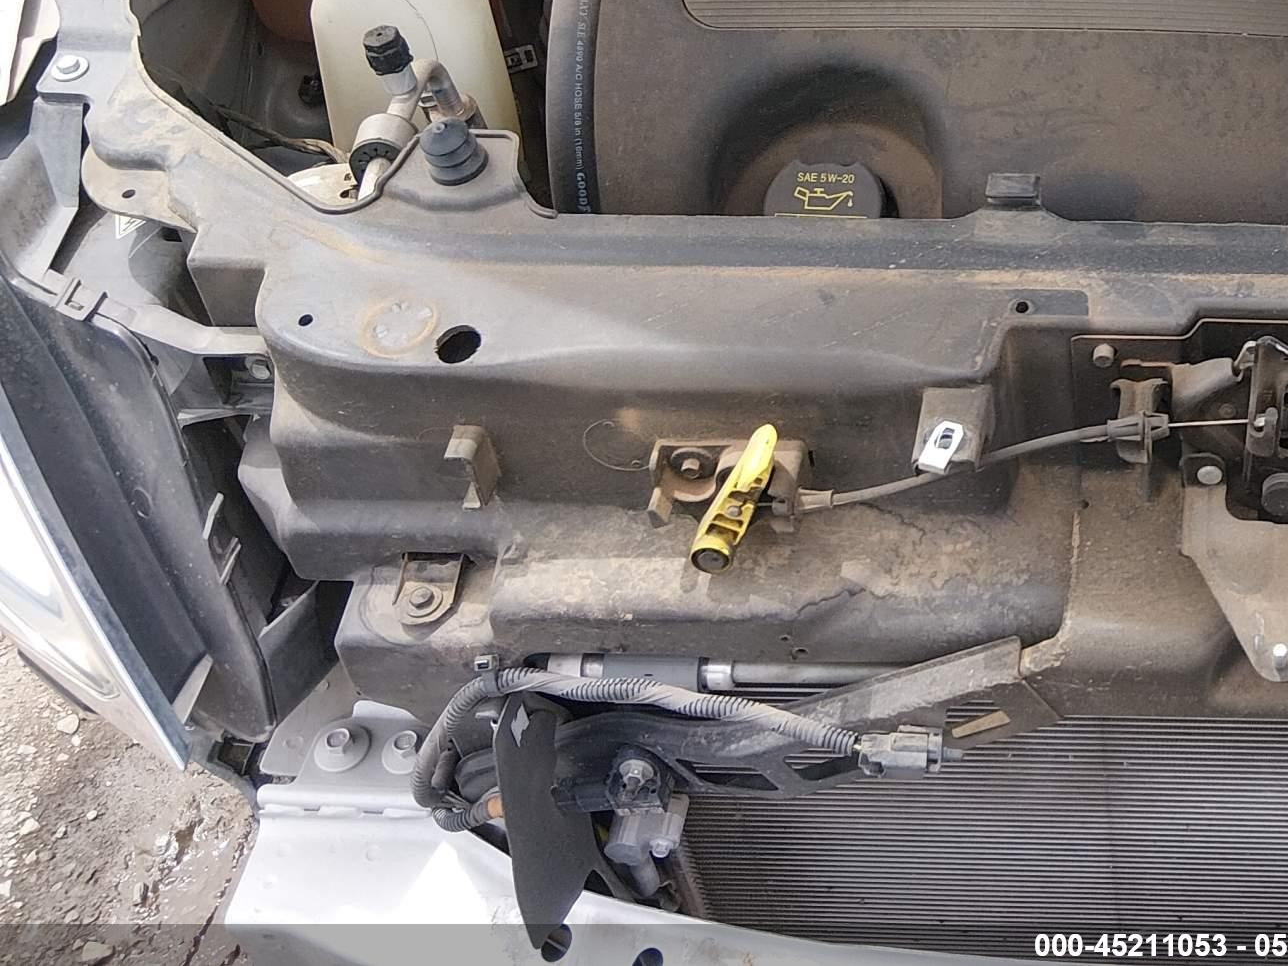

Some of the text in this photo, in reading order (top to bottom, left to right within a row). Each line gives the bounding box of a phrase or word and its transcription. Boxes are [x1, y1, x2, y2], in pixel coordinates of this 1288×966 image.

[574, 82, 583, 110] HOSE
[797, 172, 855, 184] SAE 5W-20
